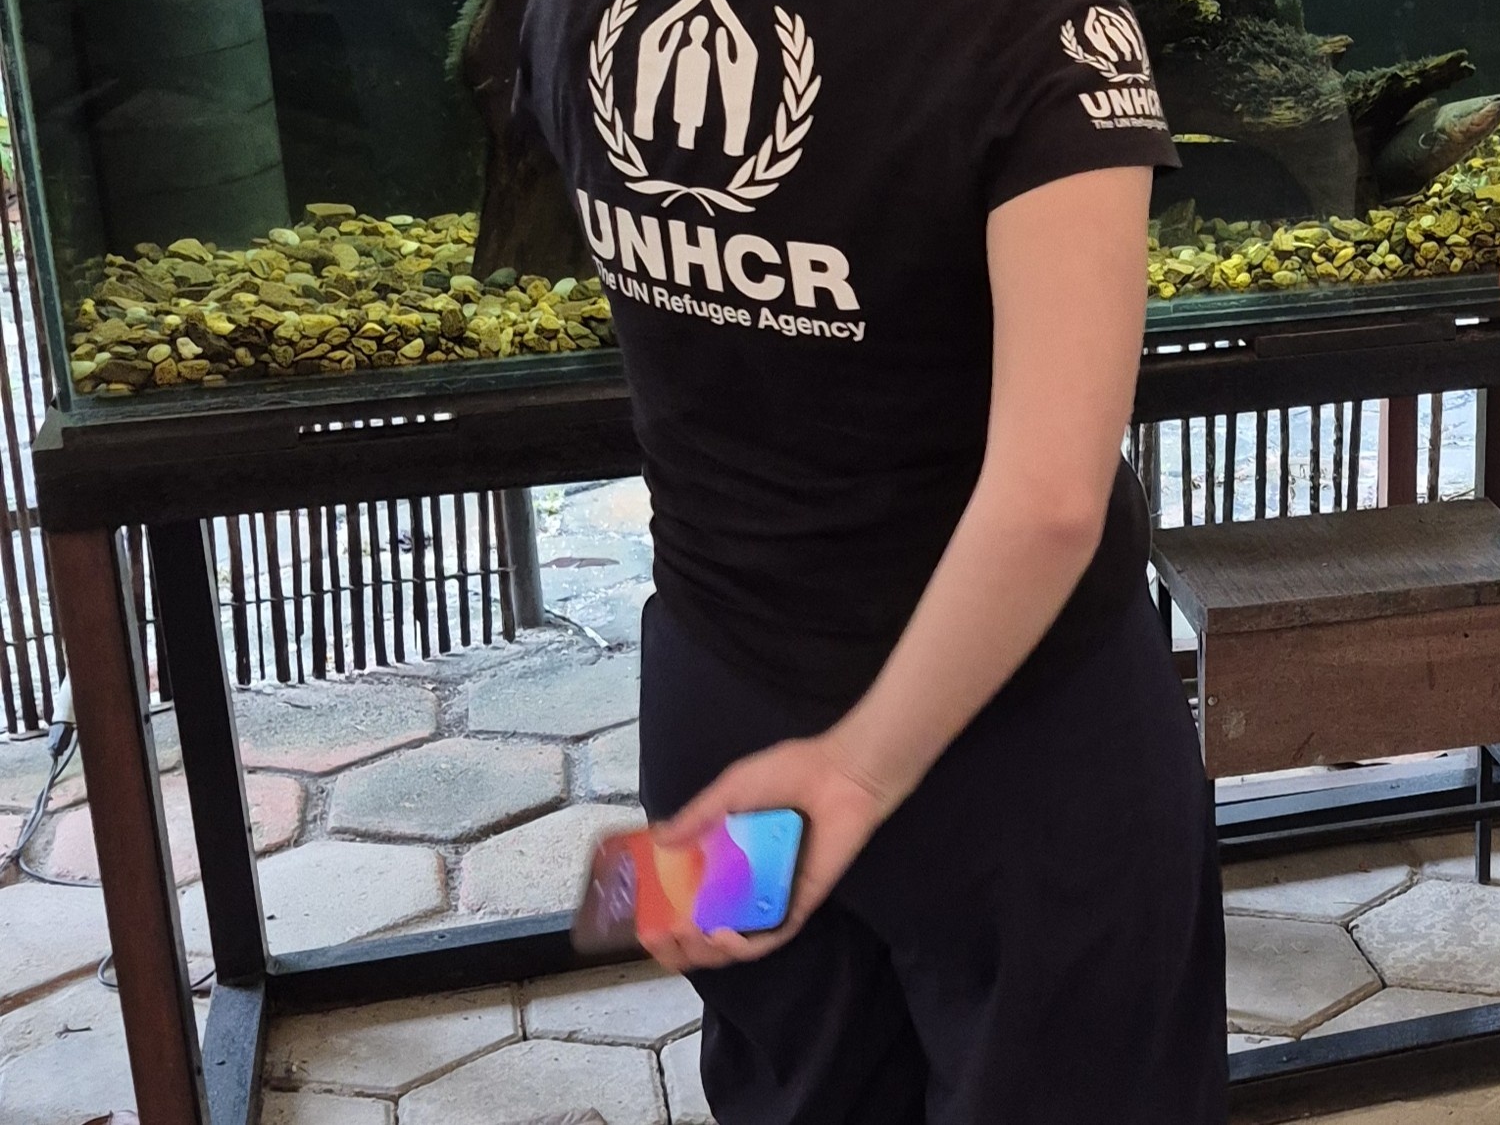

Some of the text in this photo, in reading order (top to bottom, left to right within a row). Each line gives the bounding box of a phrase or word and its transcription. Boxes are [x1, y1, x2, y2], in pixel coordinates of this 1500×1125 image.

[576, 188, 861, 311] UNHCR
[592, 255, 866, 342] The UN Refugee Agency
